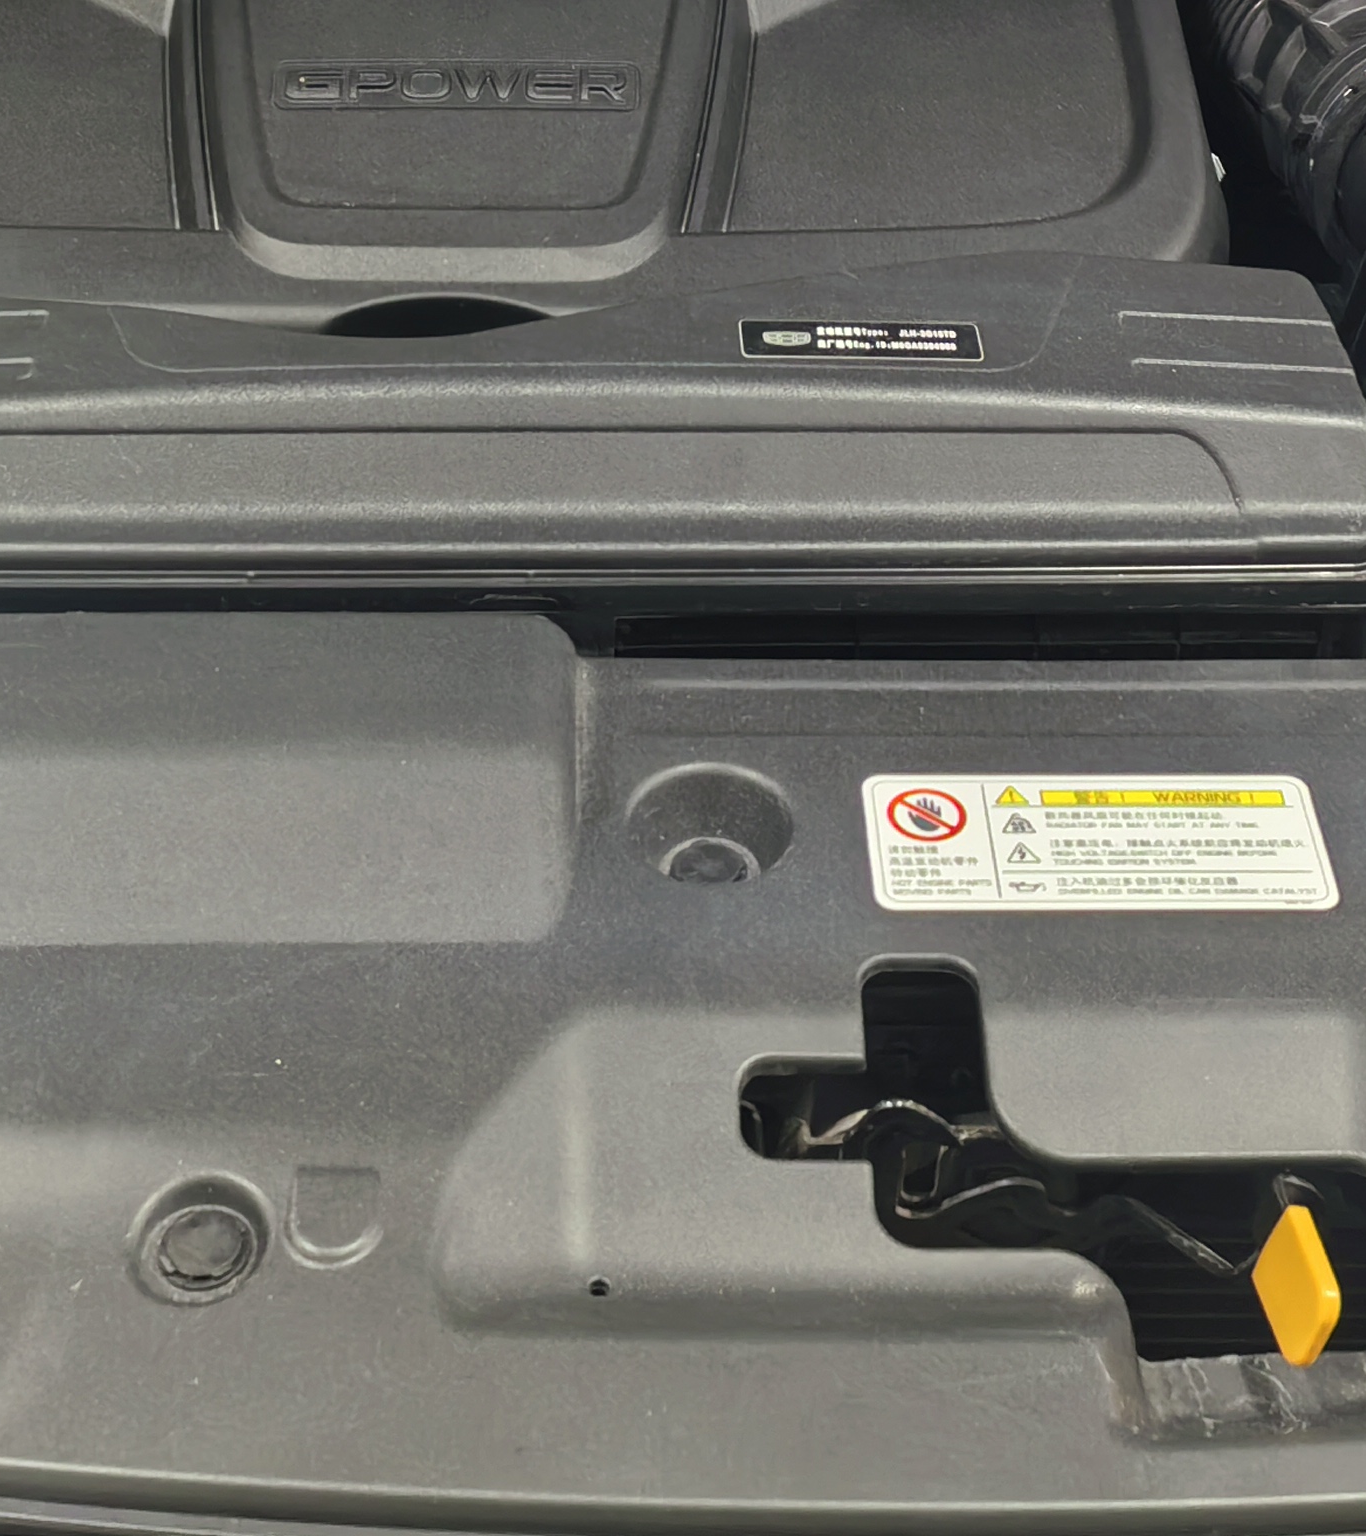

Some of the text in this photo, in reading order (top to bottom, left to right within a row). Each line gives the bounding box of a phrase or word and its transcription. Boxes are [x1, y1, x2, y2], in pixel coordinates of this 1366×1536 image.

[284, 67, 627, 104] GPOWER
[1126, 821, 1149, 829] MAY
[1153, 821, 1185, 829] START
[916, 879, 954, 887] ENGINE
[958, 879, 993, 887] PARTS
